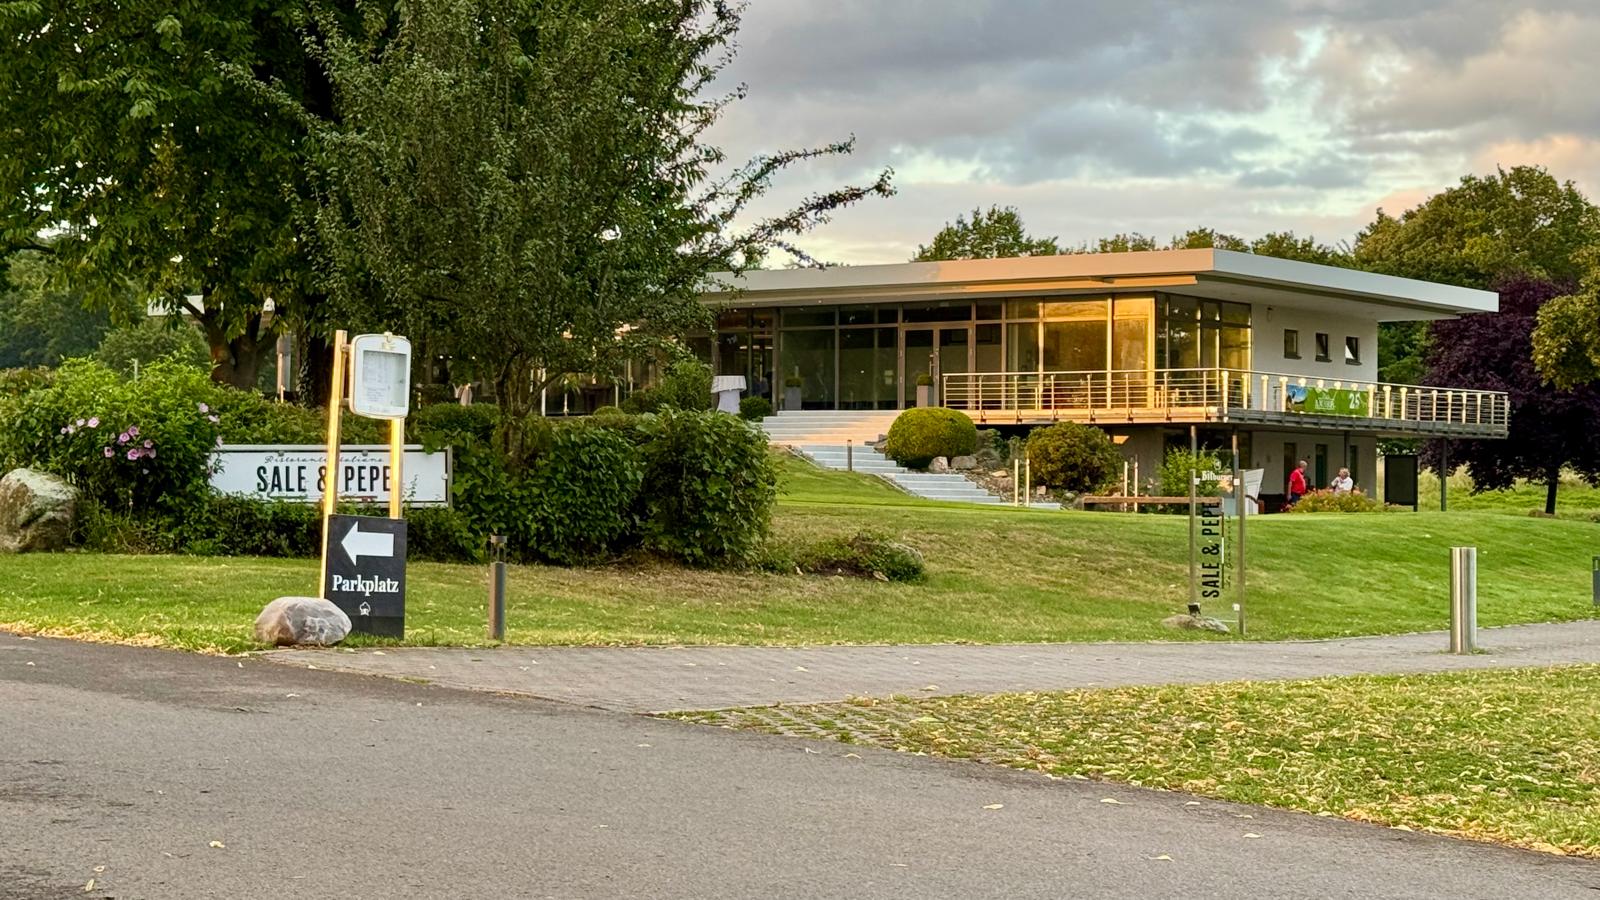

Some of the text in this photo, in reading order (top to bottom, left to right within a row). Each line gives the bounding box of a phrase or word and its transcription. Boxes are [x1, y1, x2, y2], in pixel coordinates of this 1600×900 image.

[256, 465, 307, 492] SALE
[344, 465, 391, 492] PEPE
[1202, 501, 1220, 598] SALE & PEPE
[331, 574, 399, 597] Parkplatz
